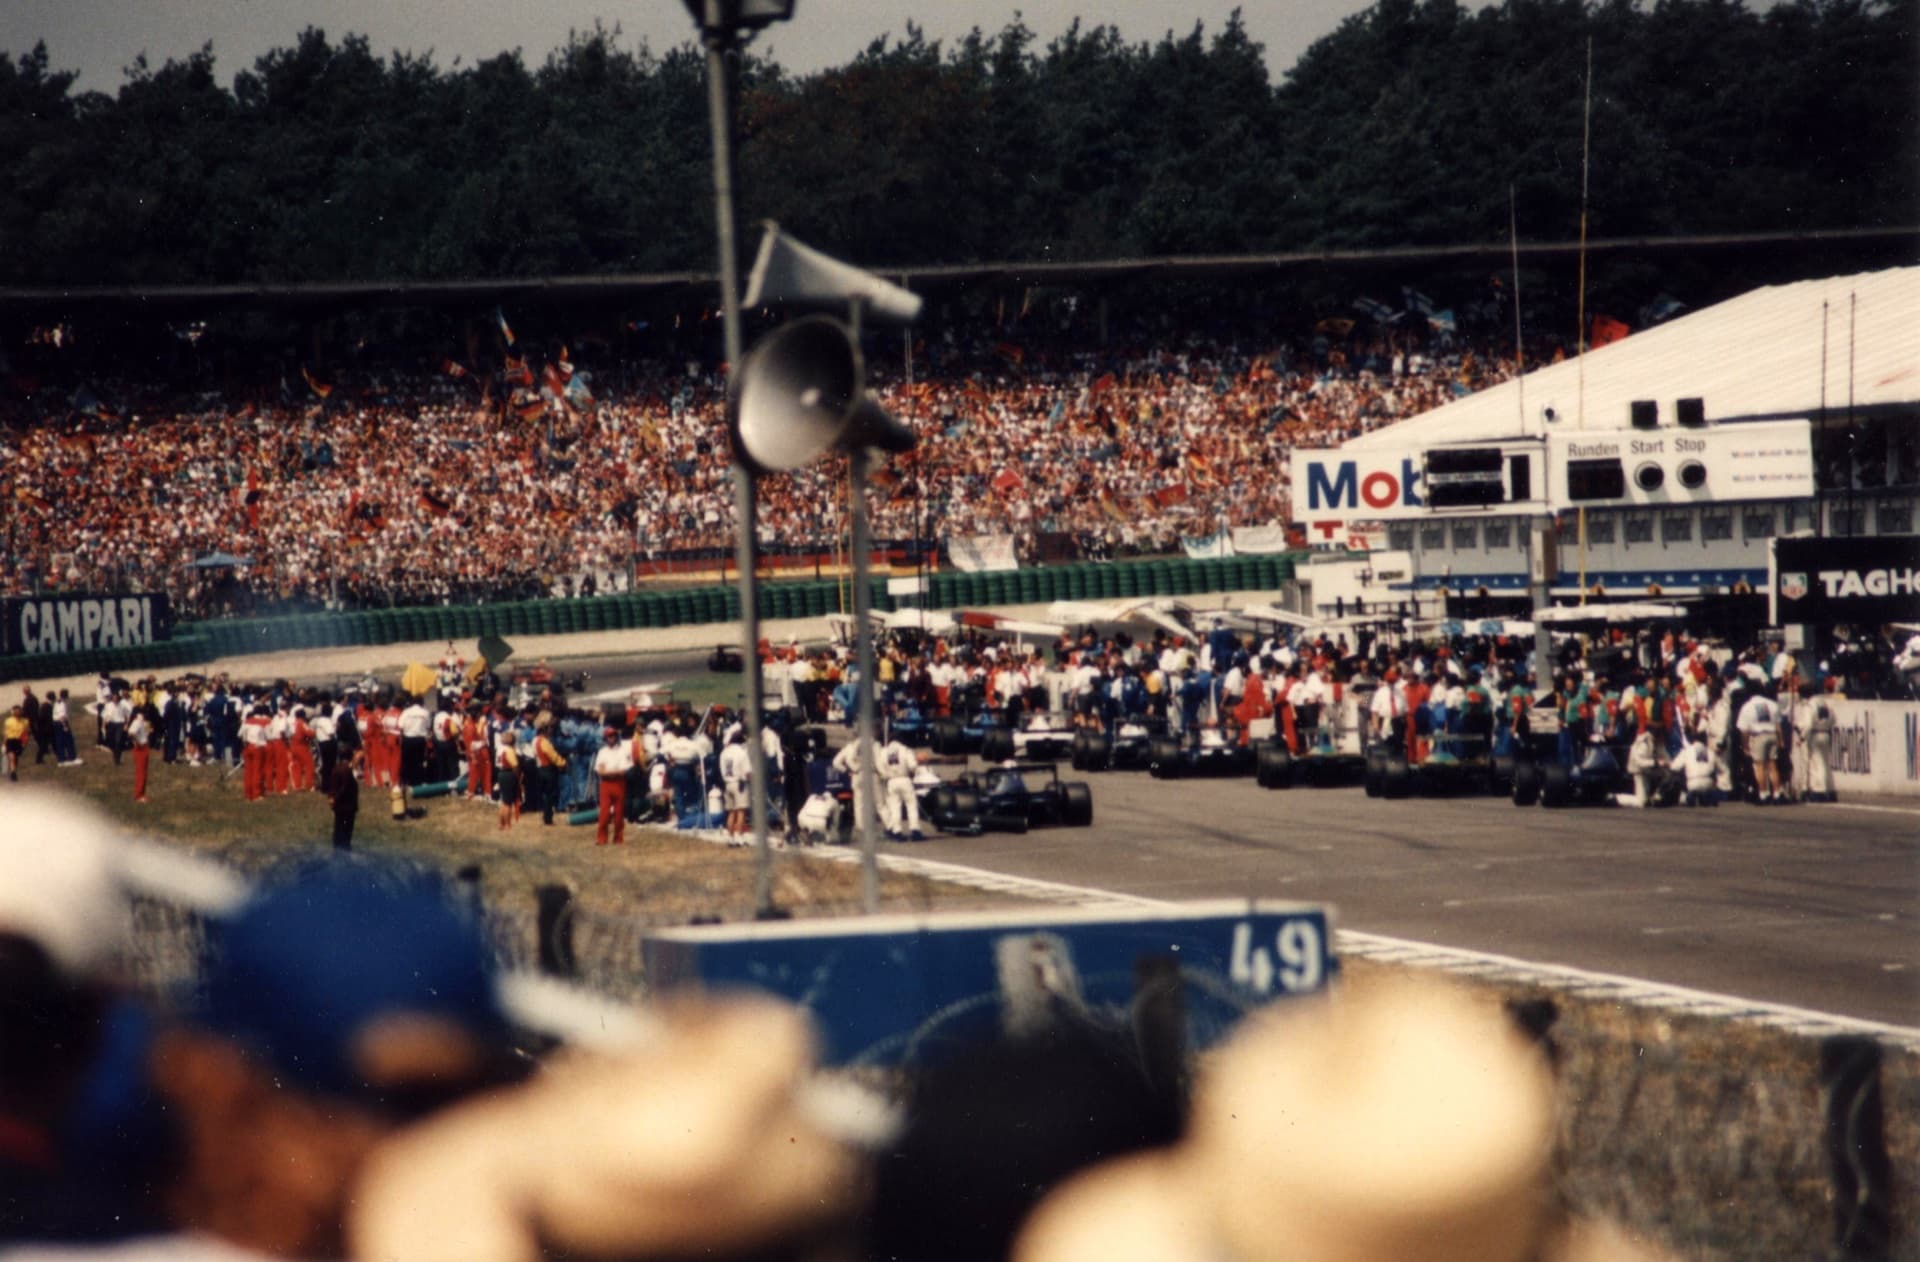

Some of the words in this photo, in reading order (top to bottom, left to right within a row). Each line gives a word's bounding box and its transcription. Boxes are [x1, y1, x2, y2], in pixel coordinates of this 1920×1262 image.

[1567, 443, 1620, 457] Runden
[1630, 440, 1664, 453] Start
[1675, 438, 1707, 453] Stop
[20, 598, 152, 654] CAMPARI
[1231, 920, 1320, 992] 49
